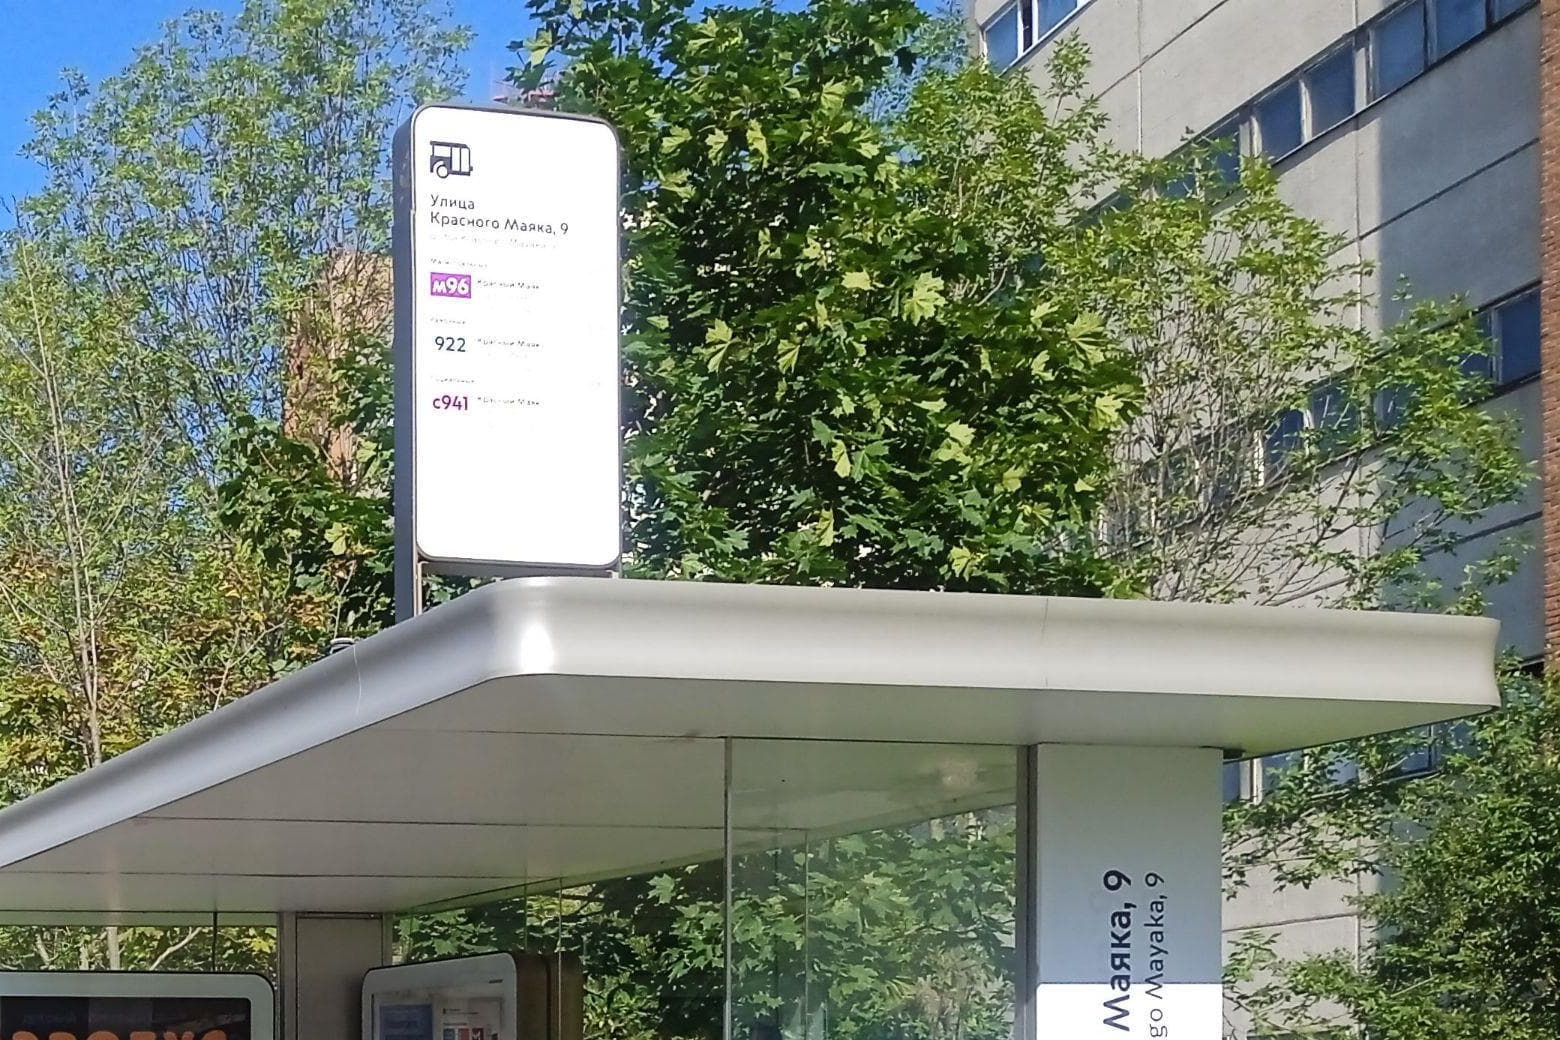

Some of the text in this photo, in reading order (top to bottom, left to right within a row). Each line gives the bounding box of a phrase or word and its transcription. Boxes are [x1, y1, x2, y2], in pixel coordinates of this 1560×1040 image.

[430, 194, 475, 210] Улица
[430, 211, 569, 236] Красного Маяка, 9
[432, 276, 470, 295] м96
[434, 336, 466, 352] 922
[432, 394, 468, 411] с941
[1102, 869, 1132, 891] 9
[1144, 872, 1165, 887] 9
[1143, 895, 1169, 999] Mayaka,
[1102, 902, 1137, 1031] Маяка,
